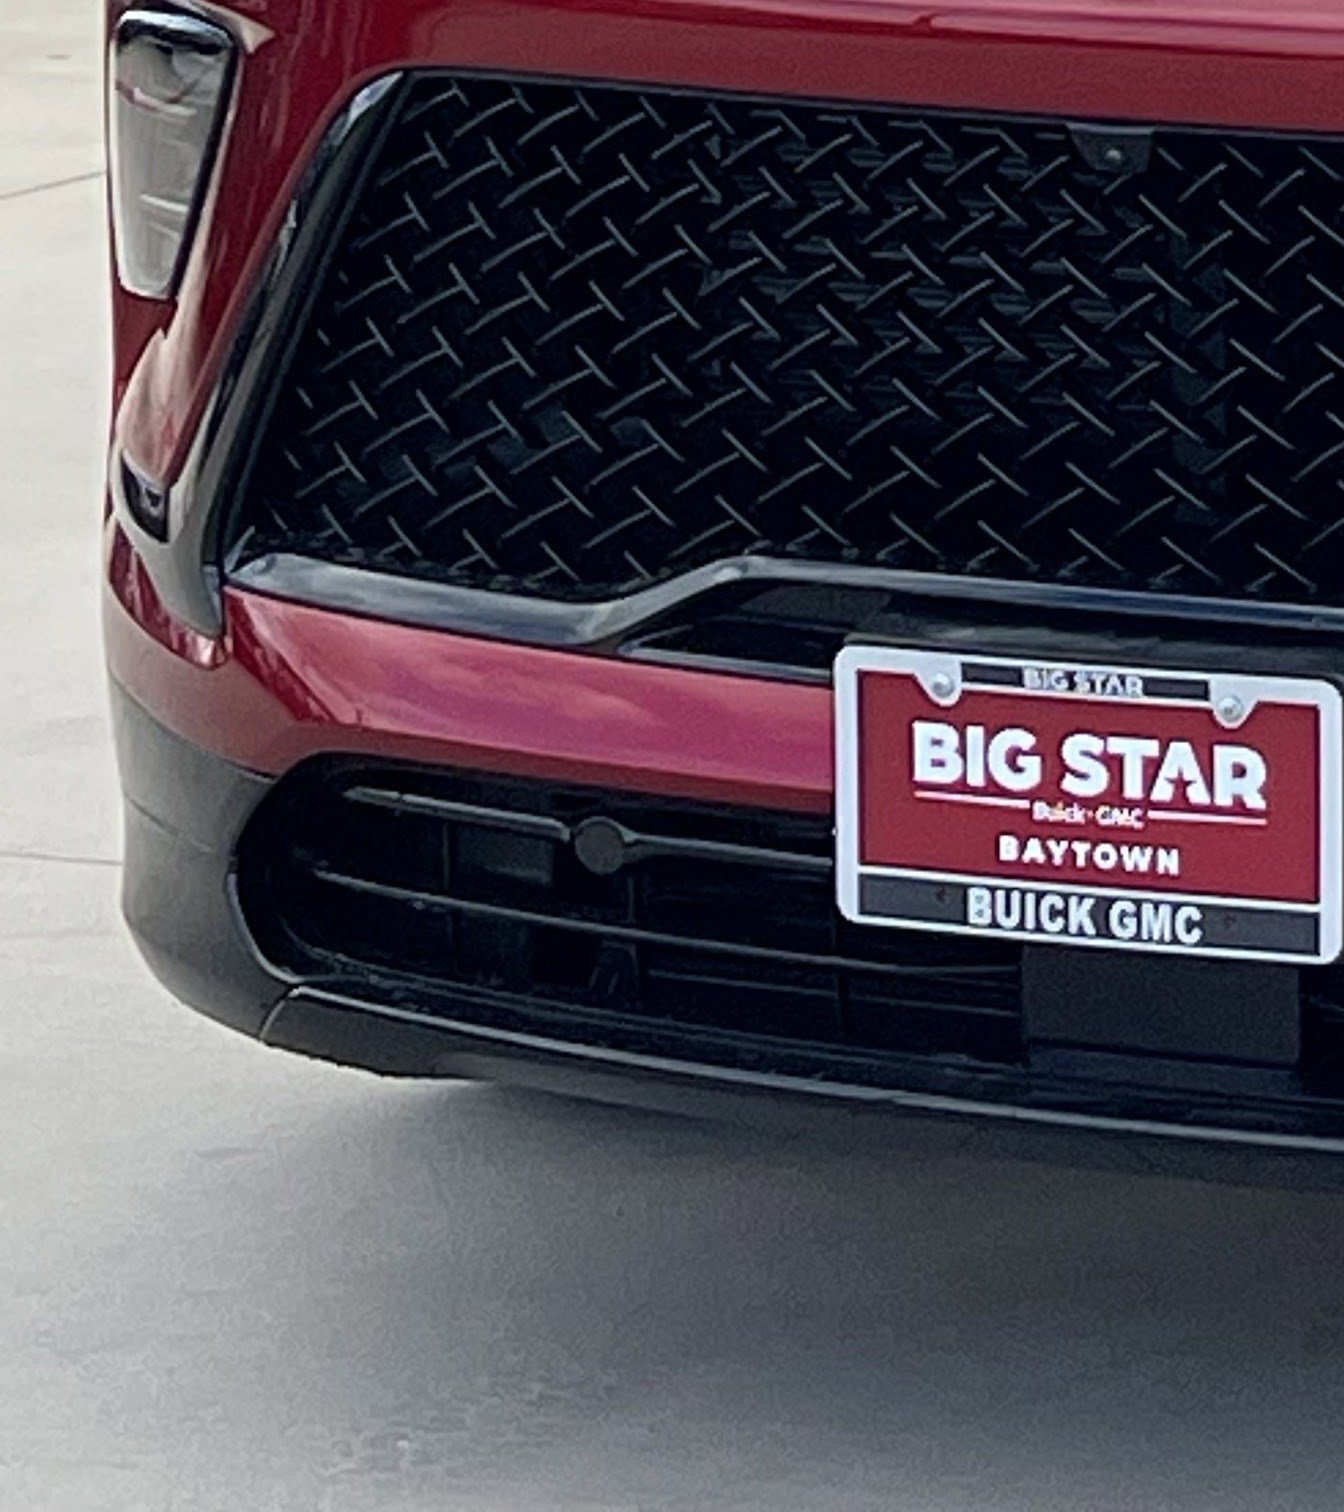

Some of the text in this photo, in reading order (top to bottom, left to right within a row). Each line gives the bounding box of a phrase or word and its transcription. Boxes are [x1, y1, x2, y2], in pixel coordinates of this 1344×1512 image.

[1023, 667, 1145, 698] BIG STAR
[912, 720, 1267, 810] BIG STAR
[999, 834, 1180, 876] BAYTOWN
[967, 886, 1203, 944] BUICK GMC
